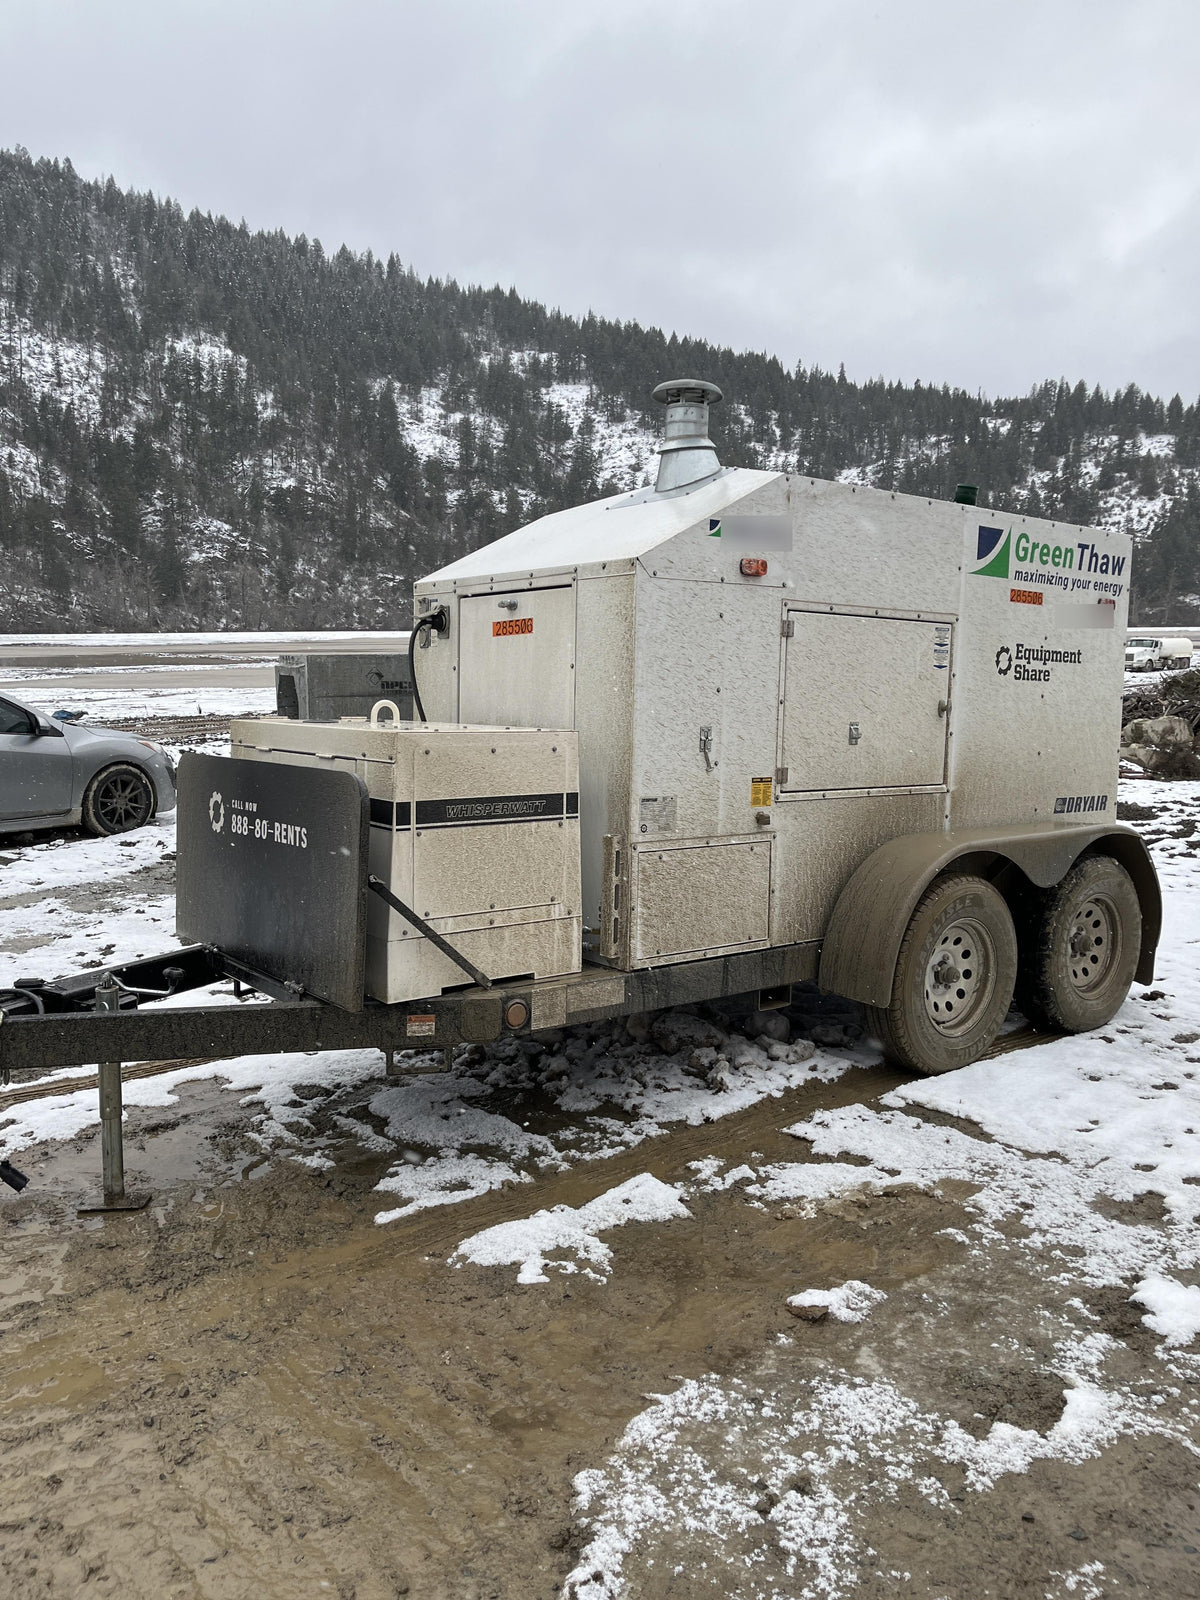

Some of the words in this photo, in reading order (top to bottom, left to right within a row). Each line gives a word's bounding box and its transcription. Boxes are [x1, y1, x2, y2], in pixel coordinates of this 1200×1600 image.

[1013, 569, 1069, 591] maximizing
[1070, 577, 1092, 592] your
[1093, 580, 1124, 597] energy
[1010, 589, 1043, 606] 285506
[495, 618, 534, 636] 285506
[1015, 643, 1082, 666] Equipment
[1013, 663, 1051, 682] Share
[231, 799, 243, 810] CALL
[244, 801, 257, 812] NOW
[446, 800, 546, 818] WHISPERWATT
[1066, 795, 1108, 814] DRYAIR
[231, 813, 308, 849] 888-80-RENTS
